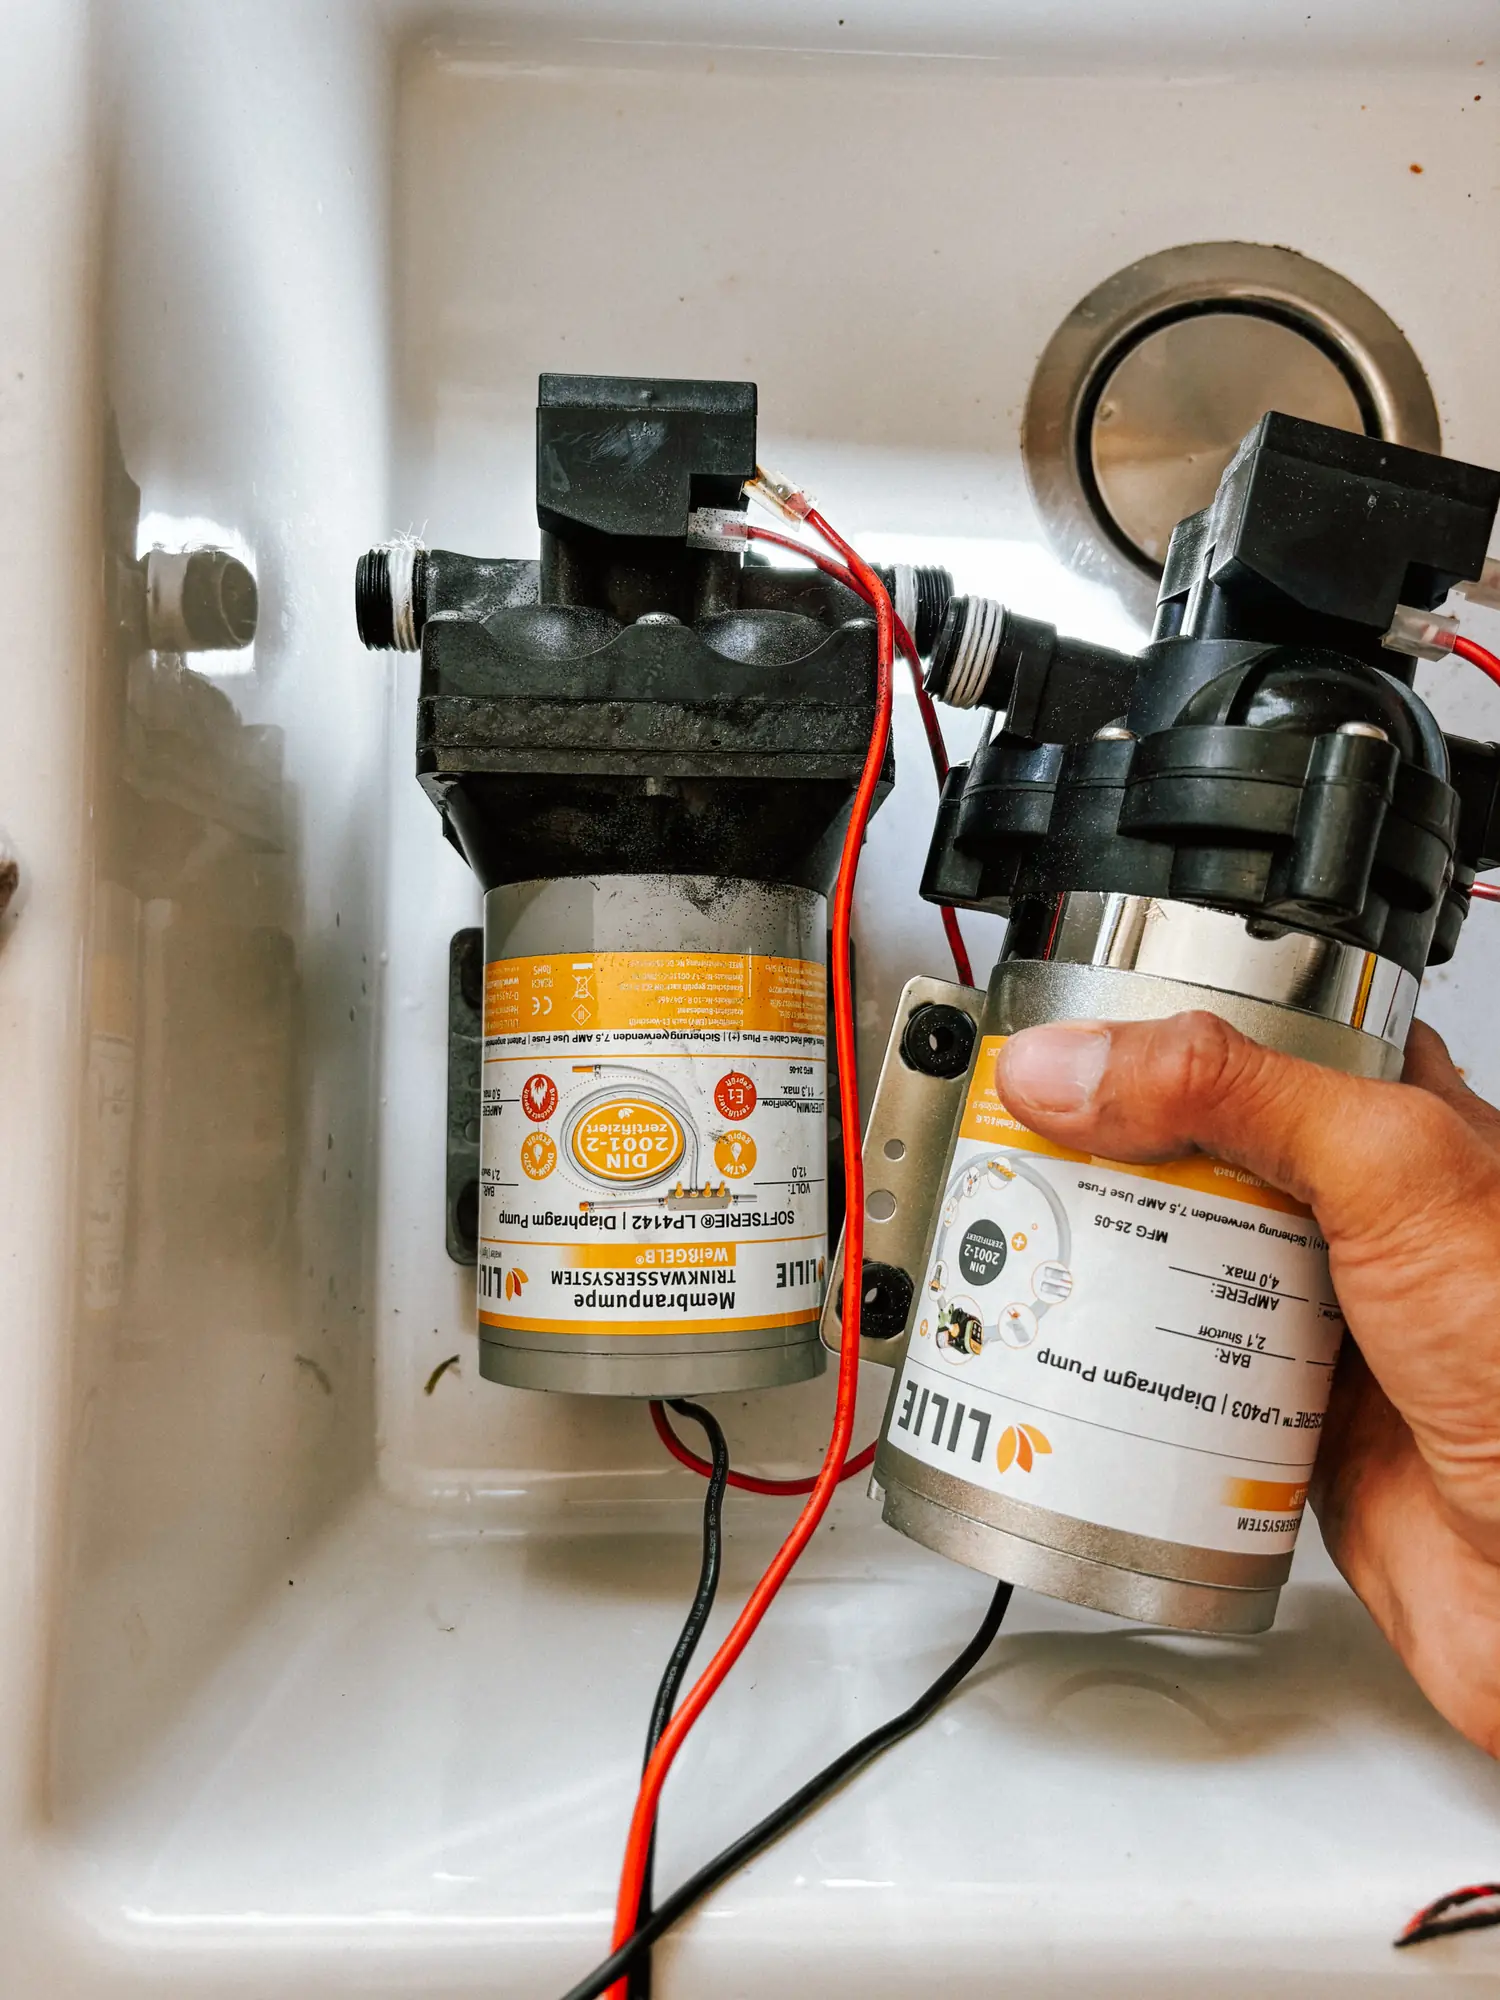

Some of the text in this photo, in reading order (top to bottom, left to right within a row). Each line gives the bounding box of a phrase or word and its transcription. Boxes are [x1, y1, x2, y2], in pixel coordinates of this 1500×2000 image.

[534, 964, 551, 975] RoHS
[532, 978, 554, 988] REACH
[682, 982, 706, 991] geprüft
[508, 1036, 526, 1046] Patent
[532, 1035, 550, 1044] Fuse
[553, 1034, 570, 1043] Use
[572, 1034, 593, 1042] AMP
[596, 1032, 610, 1042] 7,5
[613, 1032, 666, 1041] verwenden
[670, 1031, 721, 1042] Sicherung
[742, 1034, 761, 1043] Plus
[770, 1035, 790, 1044] Cable
[804, 1066, 814, 1075] MFG
[724, 1077, 752, 1090] geprüft
[780, 1085, 814, 1097] 11,3 max.
[492, 1088, 500, 1100] 5,0
[728, 1088, 744, 1104] E1
[718, 1094, 750, 1118] zertifiziert
[762, 1100, 796, 1108] OpenFlow
[586, 1123, 668, 1135] zertifiziert
[526, 1133, 552, 1146] geprüft
[586, 1136, 668, 1152] 2001-2
[523, 1152, 554, 1177] DVGW-W270
[606, 1153, 648, 1168] DIN
[492, 1168, 500, 1180] 2,1
[723, 1163, 747, 1175] KTW
[791, 1166, 806, 1178] 12,0
[1213, 1166, 1236, 1179] nach
[787, 1182, 810, 1195] VOLT:
[1076, 1180, 1106, 1196] Fuse
[1110, 1188, 1134, 1204] Use
[1137, 1196, 1166, 1211] AMP
[1168, 1202, 1188, 1217] 7,5
[498, 1210, 528, 1228] Pump
[532, 1212, 616, 1230] Diaphragm
[632, 1214, 696, 1229] LP4142
[700, 1210, 795, 1229] SOFTSERIE®
[1192, 1208, 1255, 1232] verwenden
[1094, 1214, 1168, 1244] MFG 25-05
[1258, 1222, 1308, 1247] Sicherung
[966, 1232, 1004, 1250] ZERTIFIZIERT
[636, 1247, 728, 1264] WeißGELB®
[776, 1258, 816, 1288] LILIE
[969, 1260, 986, 1274] DIN
[551, 1269, 736, 1286] TRINKWASSERSYSTEM
[1222, 1264, 1280, 1289] 4,0 max.
[574, 1289, 736, 1312] Membranpumpe
[1210, 1282, 1280, 1311] AMPERE:
[1197, 1324, 1266, 1350] 2,1 ShutOff
[1036, 1349, 1097, 1382] Pump
[1214, 1348, 1252, 1368] BAR:
[1103, 1370, 1216, 1412] Diaphragm
[1232, 1401, 1280, 1425] LP403
[897, 1380, 992, 1463] LILIE
